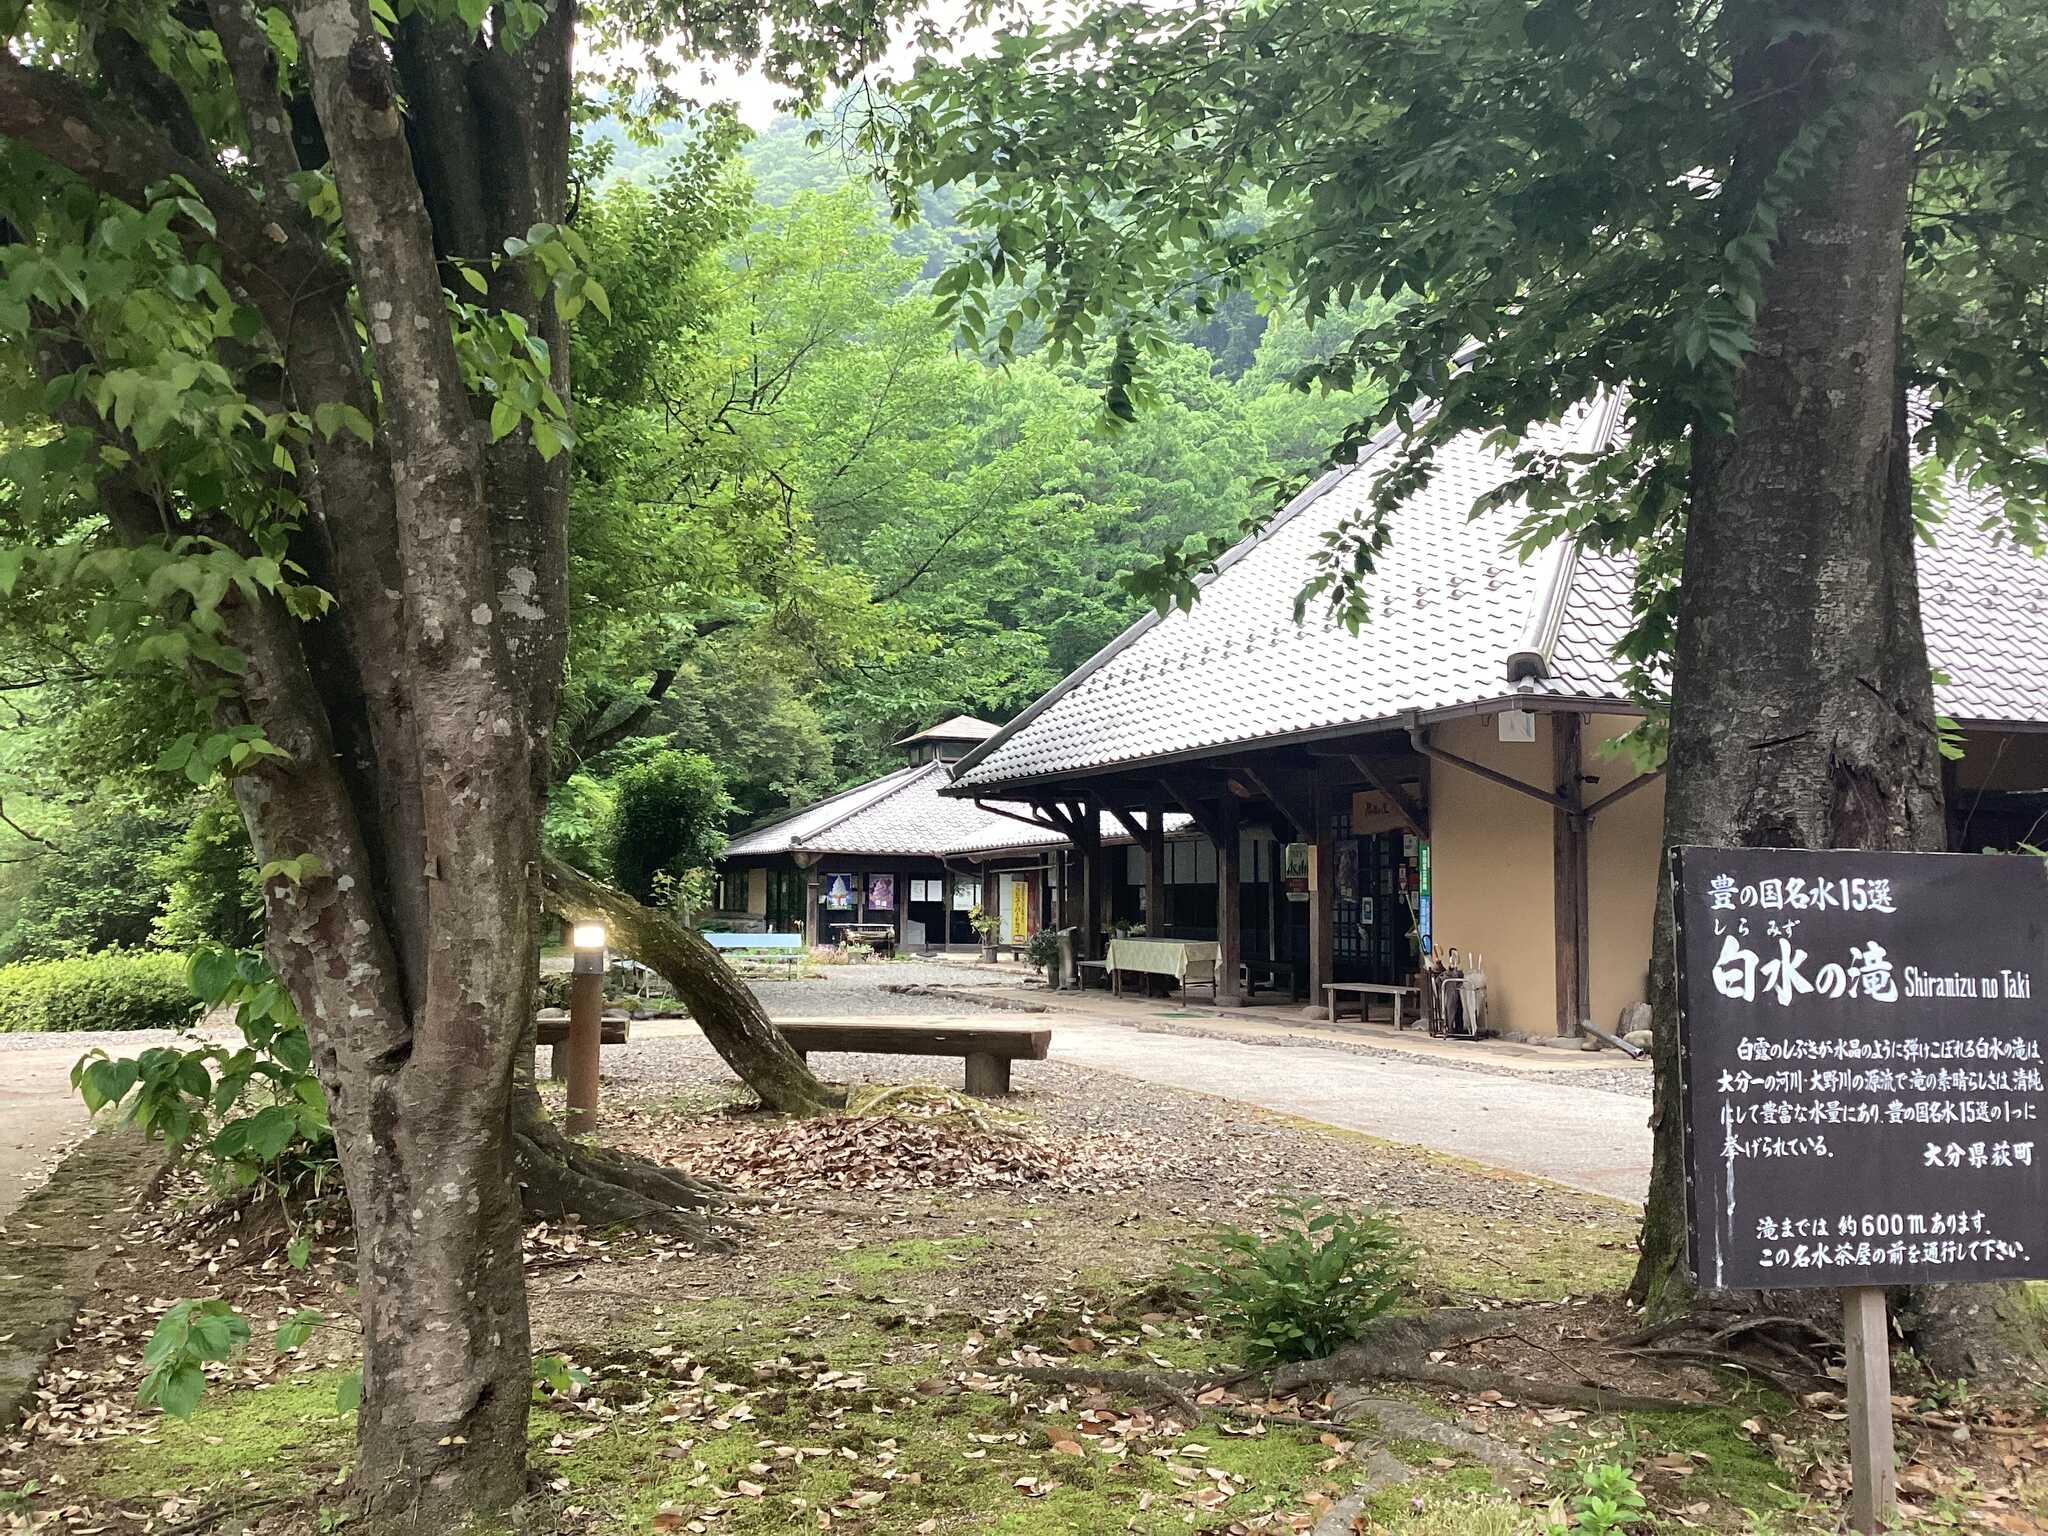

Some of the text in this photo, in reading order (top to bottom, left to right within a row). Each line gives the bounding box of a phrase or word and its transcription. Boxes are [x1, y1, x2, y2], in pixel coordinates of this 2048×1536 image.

[1707, 873, 1897, 914] 豊の国名水15選
[1712, 935, 2031, 1006] 白水の滝 Shiramizu no Taki
[1757, 1238, 2031, 1268] この名水茶屋の前を通行して下さい。
